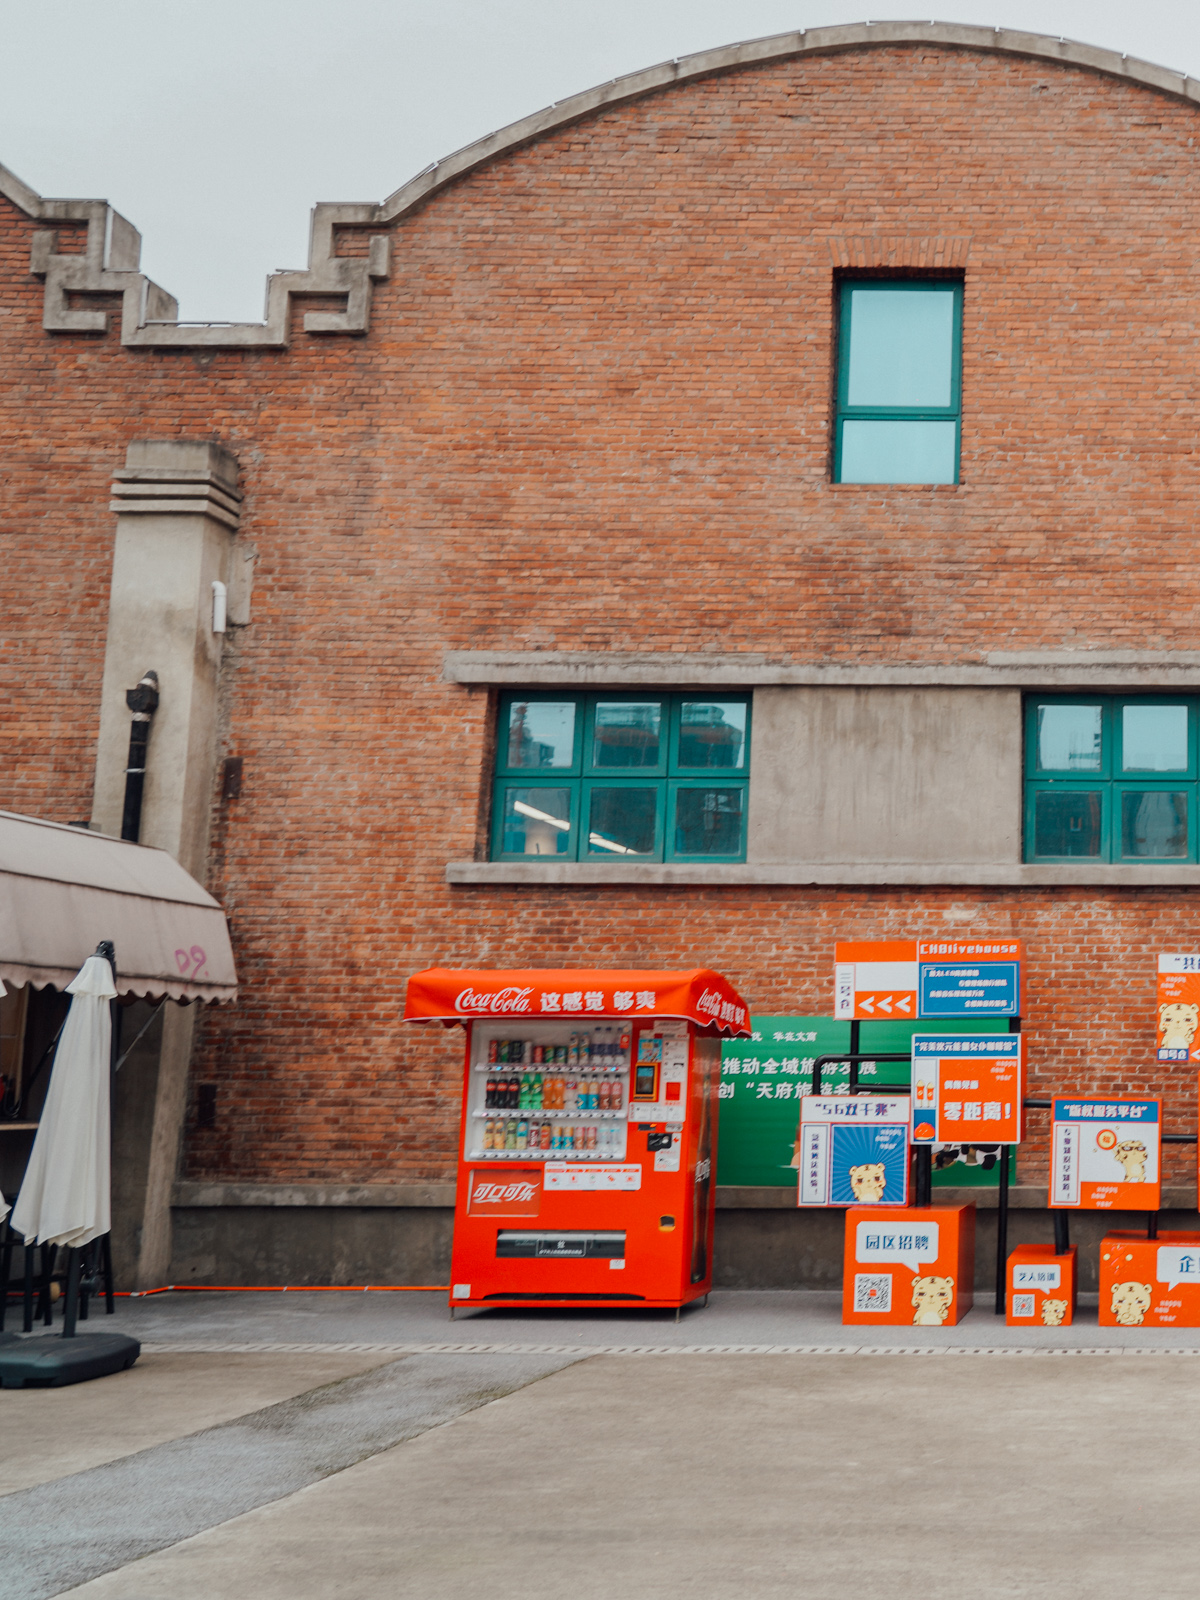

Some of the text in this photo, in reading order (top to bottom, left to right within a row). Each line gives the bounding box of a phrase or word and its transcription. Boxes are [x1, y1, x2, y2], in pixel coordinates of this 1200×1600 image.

[454, 987, 656, 1013] Coca-Cola 这感觉 够爽
[473, 1182, 540, 1204] 可口可乐
[866, 1235, 929, 1250] 园区招聘
